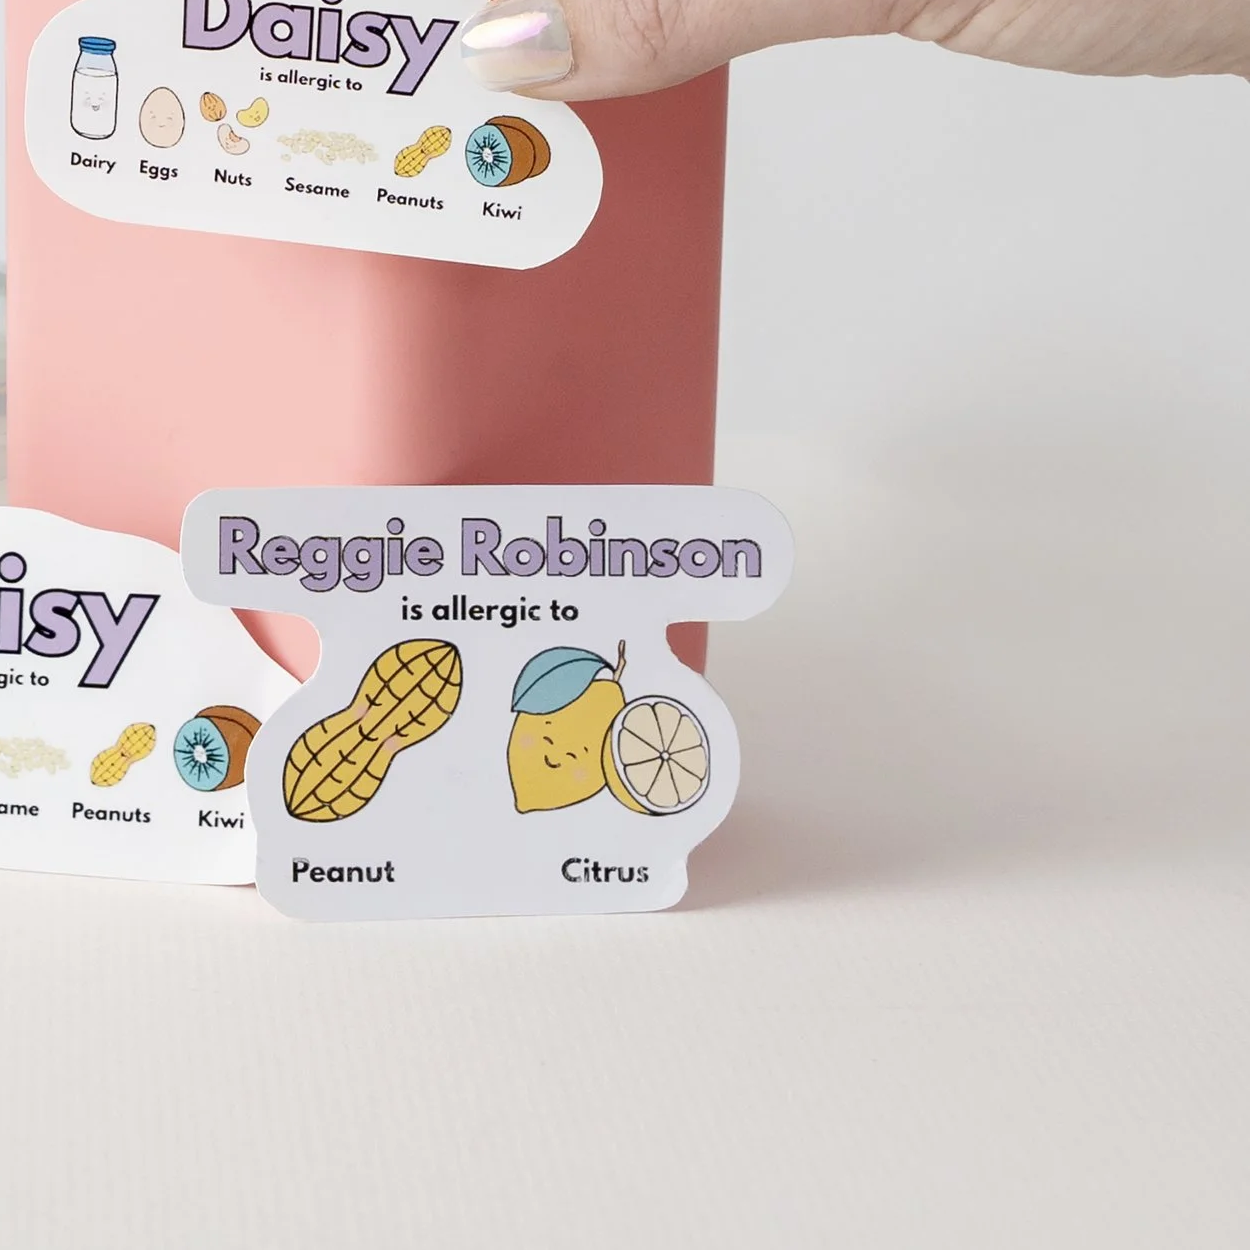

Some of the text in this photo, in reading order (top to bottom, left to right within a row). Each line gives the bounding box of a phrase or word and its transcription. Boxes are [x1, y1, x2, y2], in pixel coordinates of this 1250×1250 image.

[260, 66, 363, 92] is allergic to
[70, 151, 117, 175] Dairy
[139, 159, 178, 181] Eggs
[214, 168, 252, 187] Nuts
[284, 176, 350, 199] Sesame
[376, 187, 444, 210] Peanuts
[482, 201, 523, 221] Kiwi
[218, 515, 762, 593] Reggie Robinson
[401, 594, 579, 629] is allergic to
[29, 671, 50, 687] to
[72, 801, 151, 824] Peanuts
[198, 809, 245, 829] Kiwi
[292, 860, 395, 883] Peanut
[561, 857, 649, 883] Citrus
